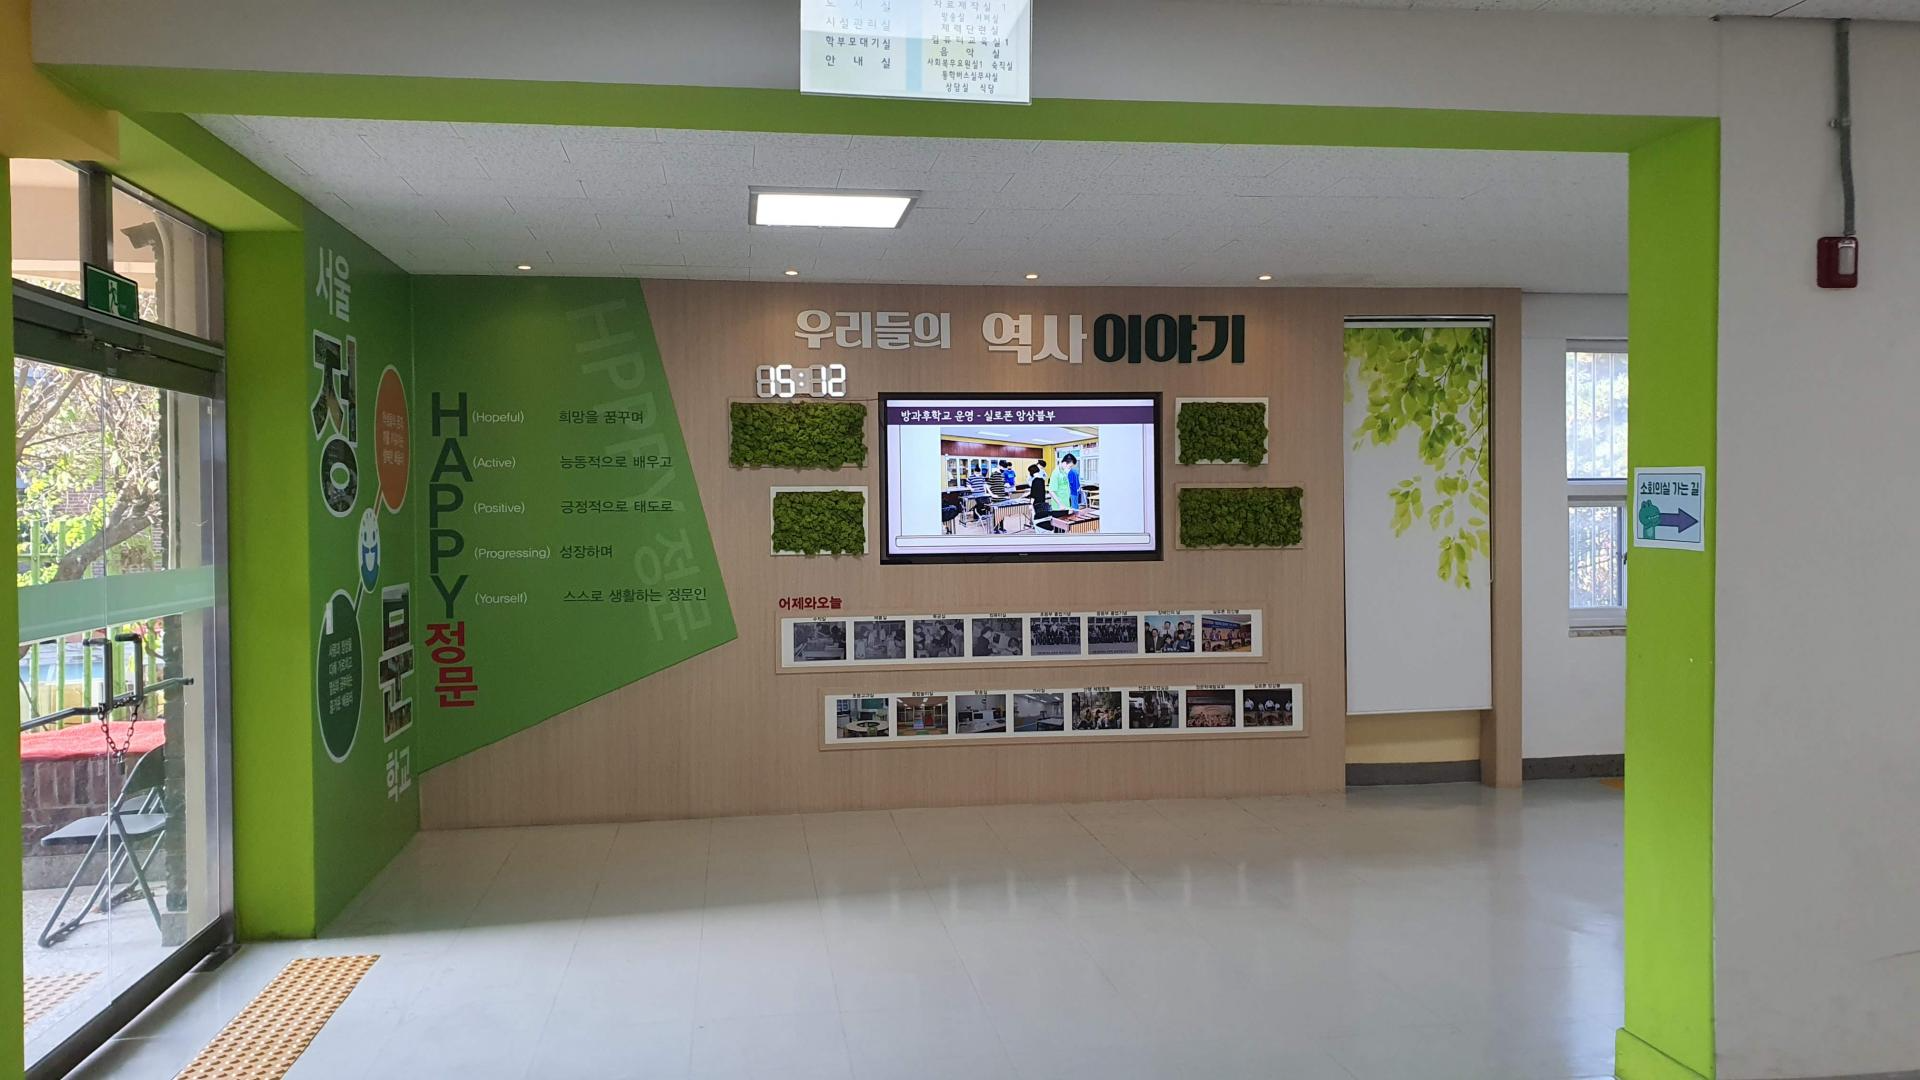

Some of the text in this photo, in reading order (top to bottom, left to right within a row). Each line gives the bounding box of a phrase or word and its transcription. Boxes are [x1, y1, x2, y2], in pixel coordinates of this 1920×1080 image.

[825, 16, 891, 31] 시설관리실
[825, 35, 891, 50] 학부모대기실
[945, 83, 994, 94] 상담실 식당
[316, 247, 351, 322] 서울
[795, 309, 1246, 364] 우리들의 역사 이야기
[757, 364, 846, 398] 15:12
[472, 411, 524, 423] (Hopeful)
[558, 410, 643, 425] 희망을 꿈꾸며
[900, 410, 952, 423] 방과후학교
[954, 410, 974, 423] 운영
[984, 410, 1013, 422] 실로폰
[1016, 409, 1056, 422] 앙상블부
[473, 456, 516, 469] (Active)
[560, 456, 672, 469] 능동적으로 배우고
[1640, 481, 1699, 496] 소회의실 가는 길
[429, 391, 473, 619] HAPPY
[473, 501, 525, 514] (Positive)
[561, 500, 674, 514] 긍정적으로 태도로
[474, 546, 551, 560] (Progressing)
[560, 545, 613, 559] 성장하며
[475, 591, 527, 605] (Yourself)
[564, 588, 707, 603] 스스로 생활하는 정문인
[778, 596, 843, 610] 어제와오늘
[424, 621, 479, 707] 정문
[385, 747, 412, 802] 학교
